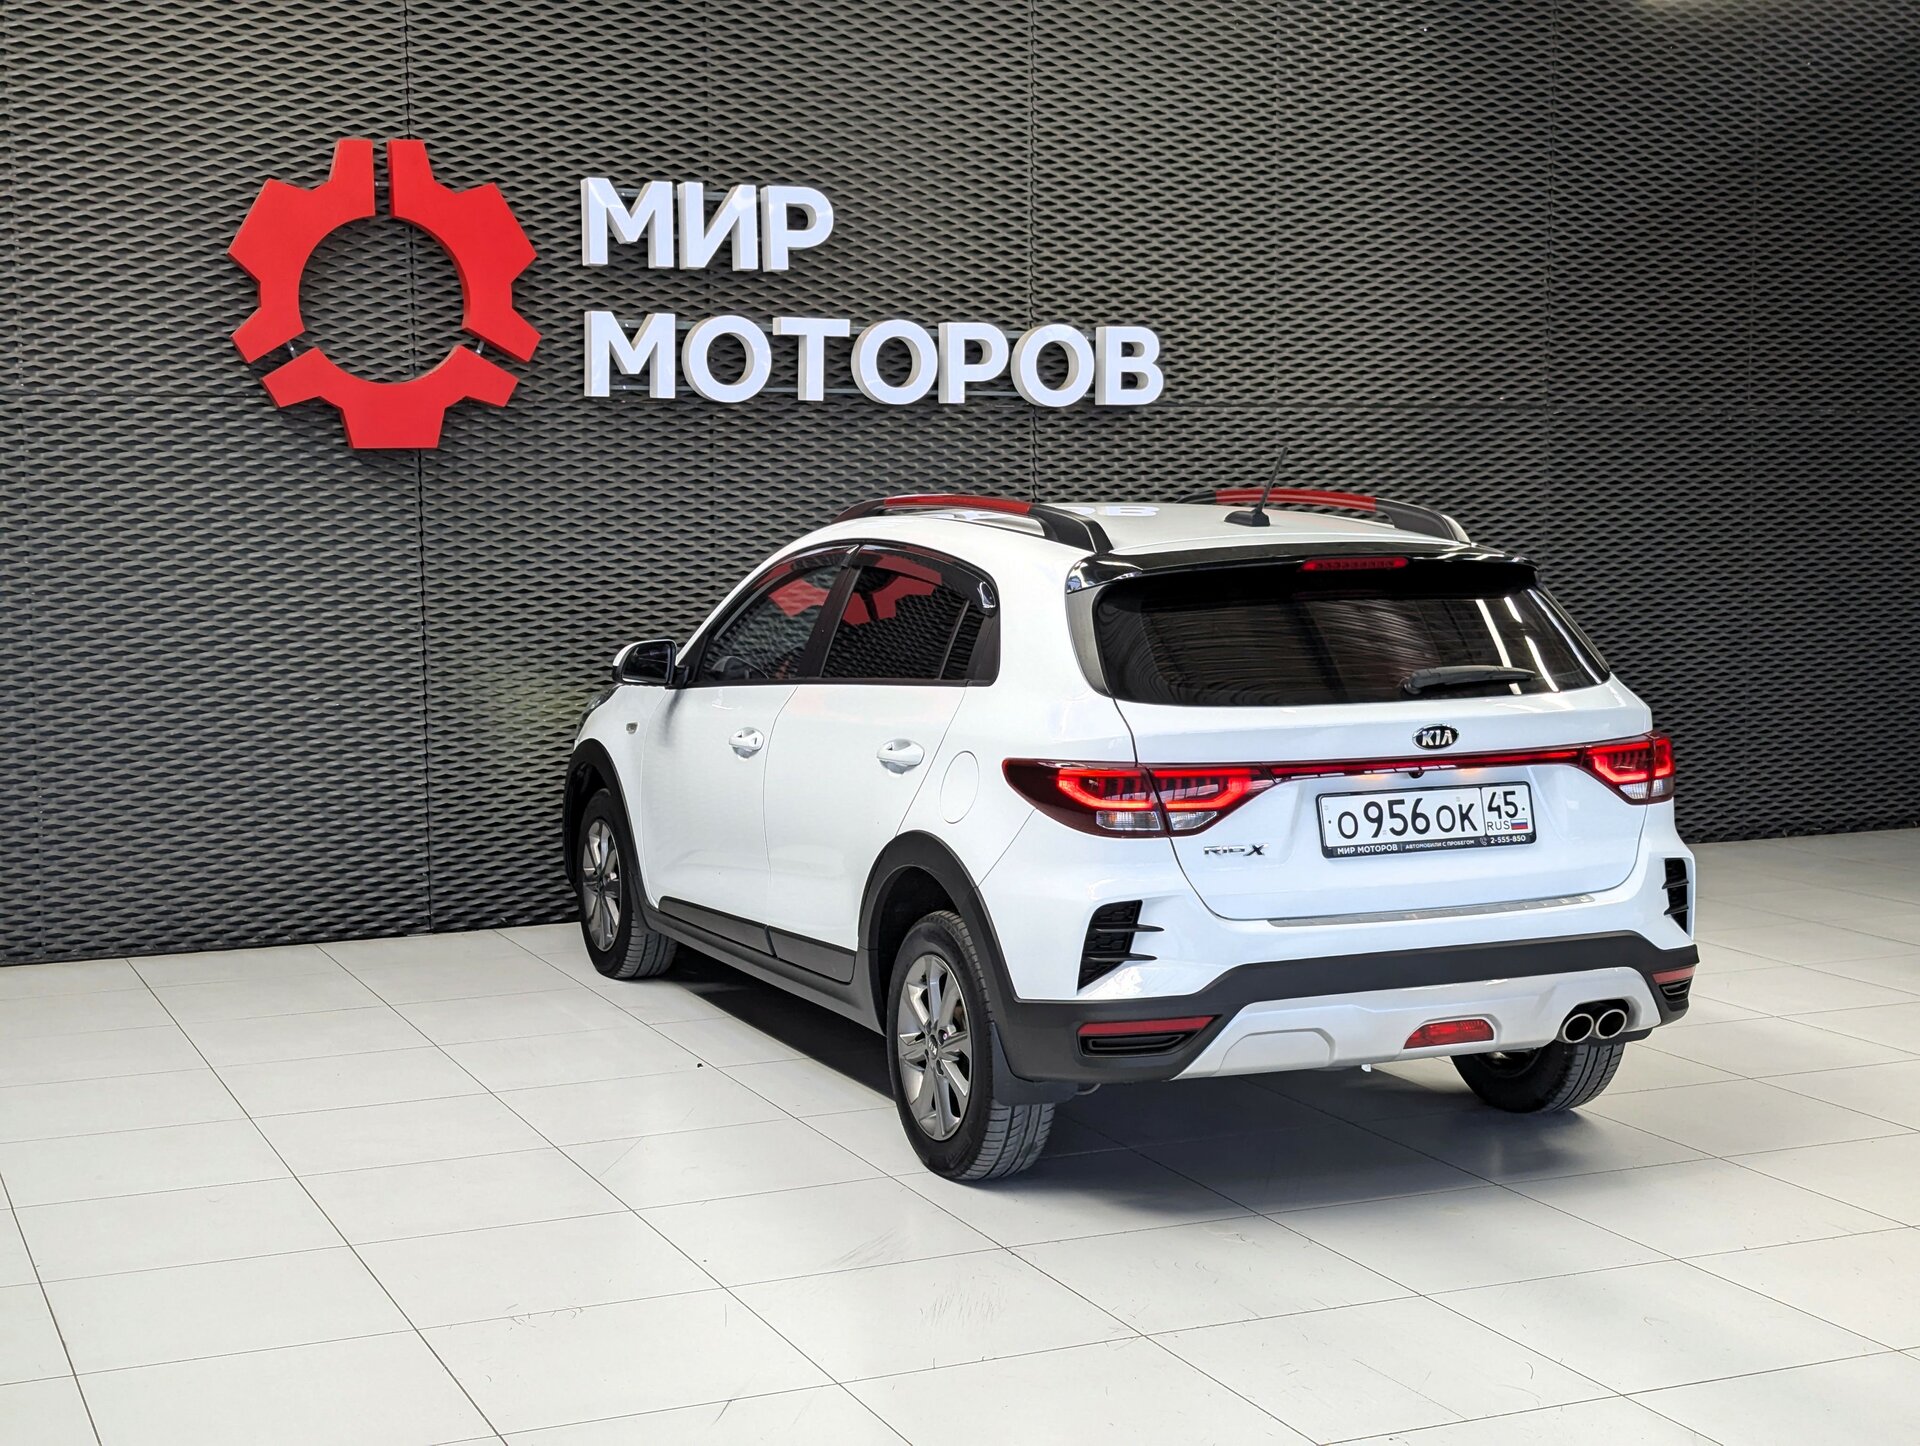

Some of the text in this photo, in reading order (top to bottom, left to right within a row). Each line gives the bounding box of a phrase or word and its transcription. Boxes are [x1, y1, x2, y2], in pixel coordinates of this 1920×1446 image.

[580, 177, 834, 272] МИР
[584, 311, 1164, 408] МОТОРОВ
[1421, 729, 1453, 746] KIA
[1487, 790, 1519, 820] 45
[1486, 820, 1511, 831] RUS
[1337, 846, 1356, 855] МИР
[1357, 843, 1398, 854] МОТОРОВ
[1405, 840, 1442, 850] АВТОМОБИЛИ
[1446, 839, 1475, 847] ПРОБЕГОМ
[1490, 834, 1527, 844] 2-555-850
